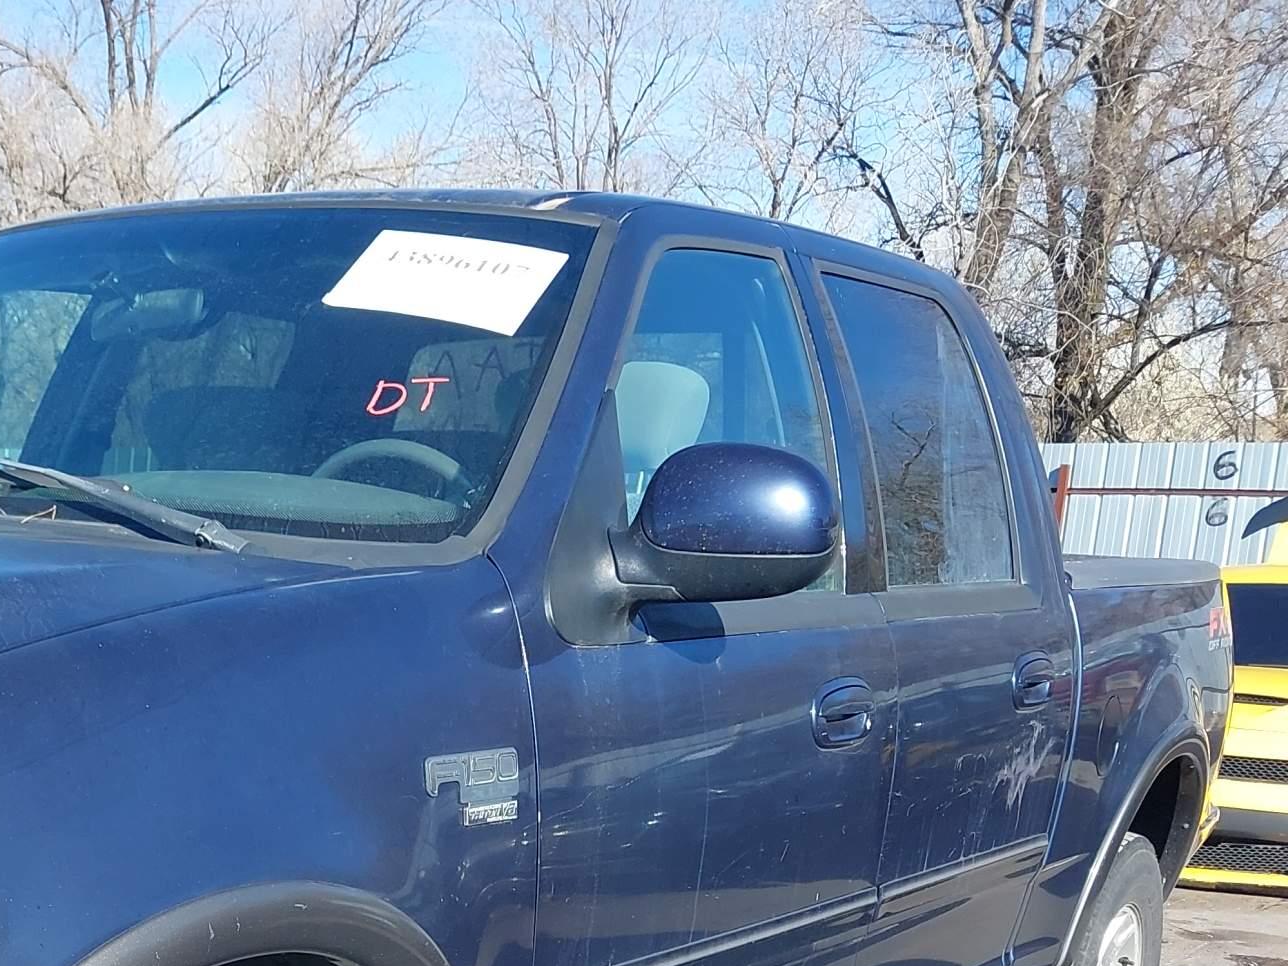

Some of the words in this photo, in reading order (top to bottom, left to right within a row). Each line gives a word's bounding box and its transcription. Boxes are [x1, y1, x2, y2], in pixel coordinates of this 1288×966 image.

[365, 376, 450, 416] DT
[1212, 449, 1238, 481] 6
[1204, 497, 1230, 527] 6
